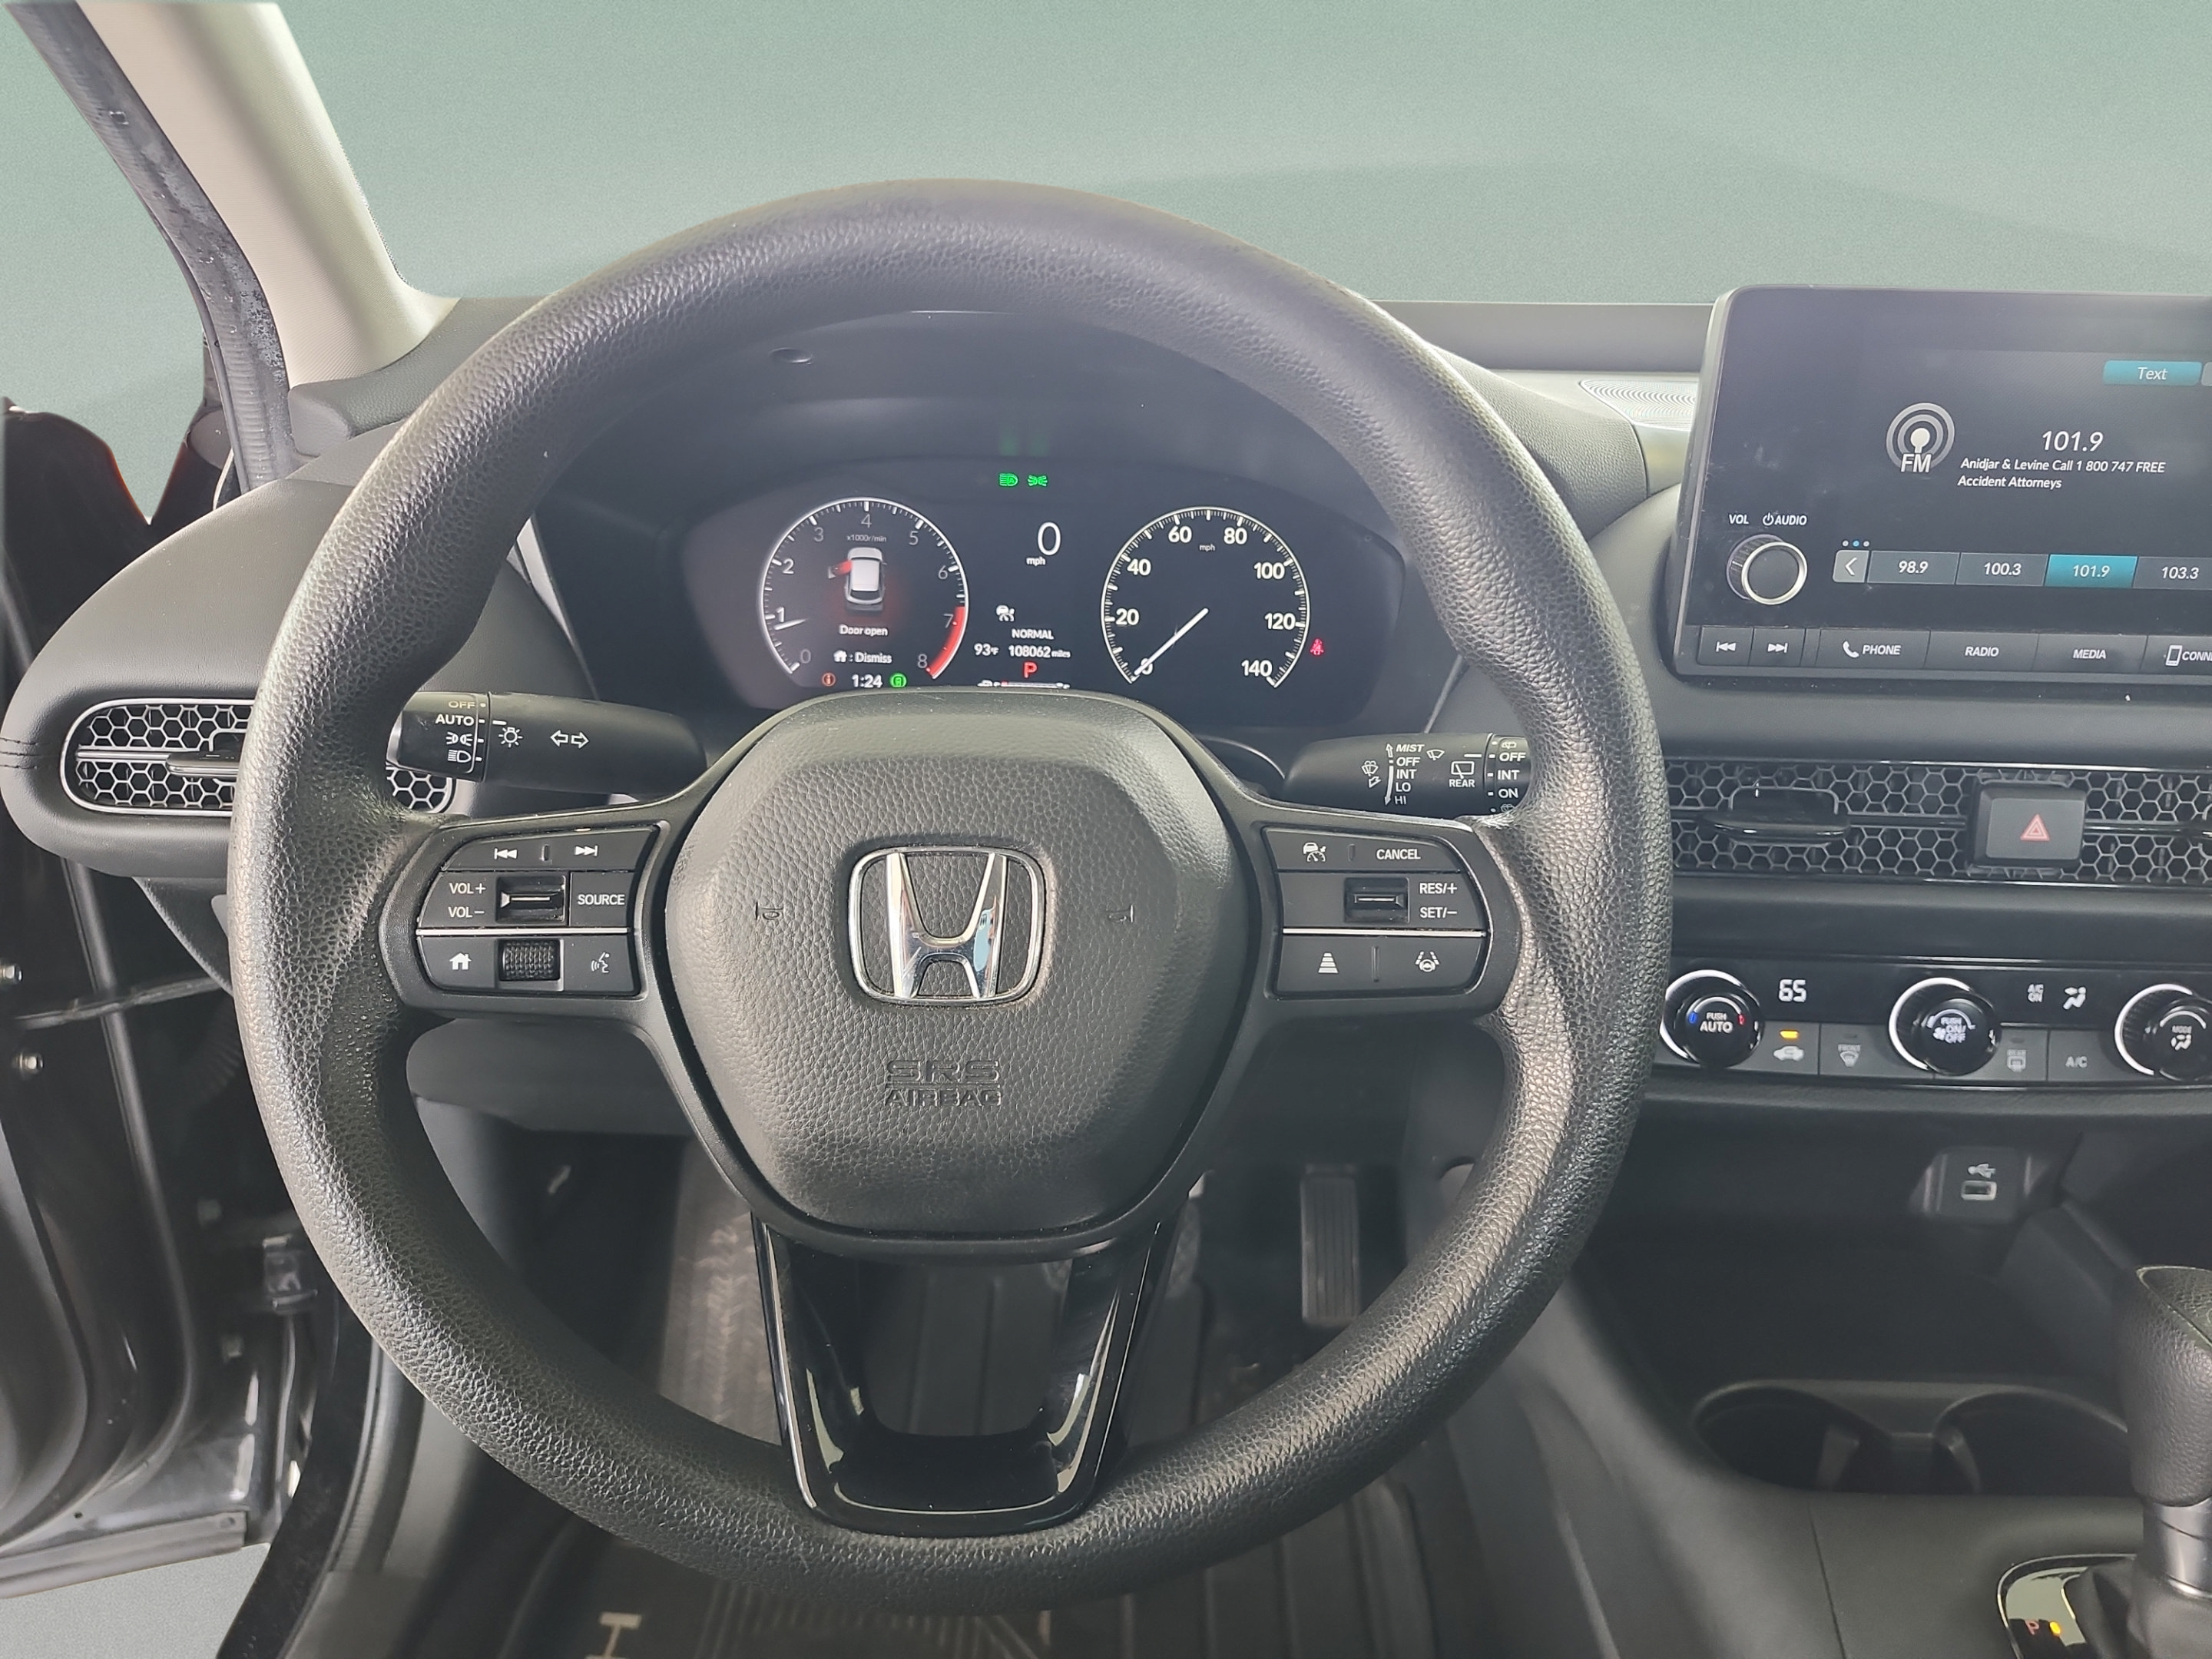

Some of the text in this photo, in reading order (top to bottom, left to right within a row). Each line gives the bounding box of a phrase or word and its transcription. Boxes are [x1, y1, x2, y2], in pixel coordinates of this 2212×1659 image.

[2137, 366, 2167, 380] Text
[2041, 430, 2104, 452] 101.9
[1900, 453, 1932, 473] FM
[1960, 458, 2166, 473] Anidjar & Levine Call 1 800 747 FREE
[1958, 475, 2062, 490] Accident Attorneys
[861, 514, 872, 528] 4
[1728, 514, 1749, 525] VOL
[1774, 515, 1808, 526] AUDIO
[814, 528, 824, 542] 3
[909, 531, 919, 545] 5
[1038, 522, 1061, 556] 0
[1168, 525, 1192, 543] 60
[1224, 527, 1247, 545] 80
[1199, 543, 1215, 552] mph
[783, 559, 794, 575] 2
[1025, 557, 1046, 567] mph
[1128, 558, 1151, 576] 40
[1899, 560, 1929, 575] 98.9
[1983, 561, 2022, 576] 100.3
[939, 565, 948, 579] 6
[1254, 562, 1285, 580] 100
[2071, 562, 2110, 578] 101.9
[2161, 565, 2199, 580] 103.3
[776, 607, 785, 622] 1
[944, 614, 953, 628] 7
[1116, 608, 1139, 626] 20
[1265, 612, 1295, 631] 120
[839, 624, 888, 637] Door open
[1011, 628, 1054, 640] NORMAL
[800, 649, 811, 664] 0
[1008, 645, 1051, 658] 108062
[1863, 644, 1901, 656] PHONE
[1965, 645, 1999, 657] RADIO
[2073, 649, 2107, 660] MEDIA
[2182, 651, 2212, 661] CONN
[855, 652, 892, 664] Dismiss
[917, 654, 928, 668] 8
[1023, 661, 1038, 678] P
[1242, 660, 1272, 677] 140
[852, 674, 883, 688] 1:24
[449, 700, 475, 710] OFF
[435, 714, 475, 727] AUTO
[1396, 743, 1424, 753] MIST
[1396, 757, 1420, 767] OFF
[1499, 752, 1525, 762] OFF
[1396, 769, 1417, 780] INT
[1498, 770, 1519, 780] INT
[1396, 782, 1411, 793] LO
[1449, 779, 1475, 788] REAR
[1395, 795, 1407, 805] HI
[1498, 788, 1518, 800] ON
[1376, 849, 1420, 860] CANCEL
[1419, 883, 1458, 895] RES/+
[578, 894, 625, 906] SOURCE
[1778, 979, 1807, 1002] 65
[1706, 1012, 1727, 1021] PUSH
[1700, 1021, 1734, 1033] AUTO
[2065, 1055, 2088, 1068] A/C
[886, 1059, 999, 1081] SRS
[885, 1088, 1002, 1107] AIRBAG
[2024, 1618, 2039, 1635] P
